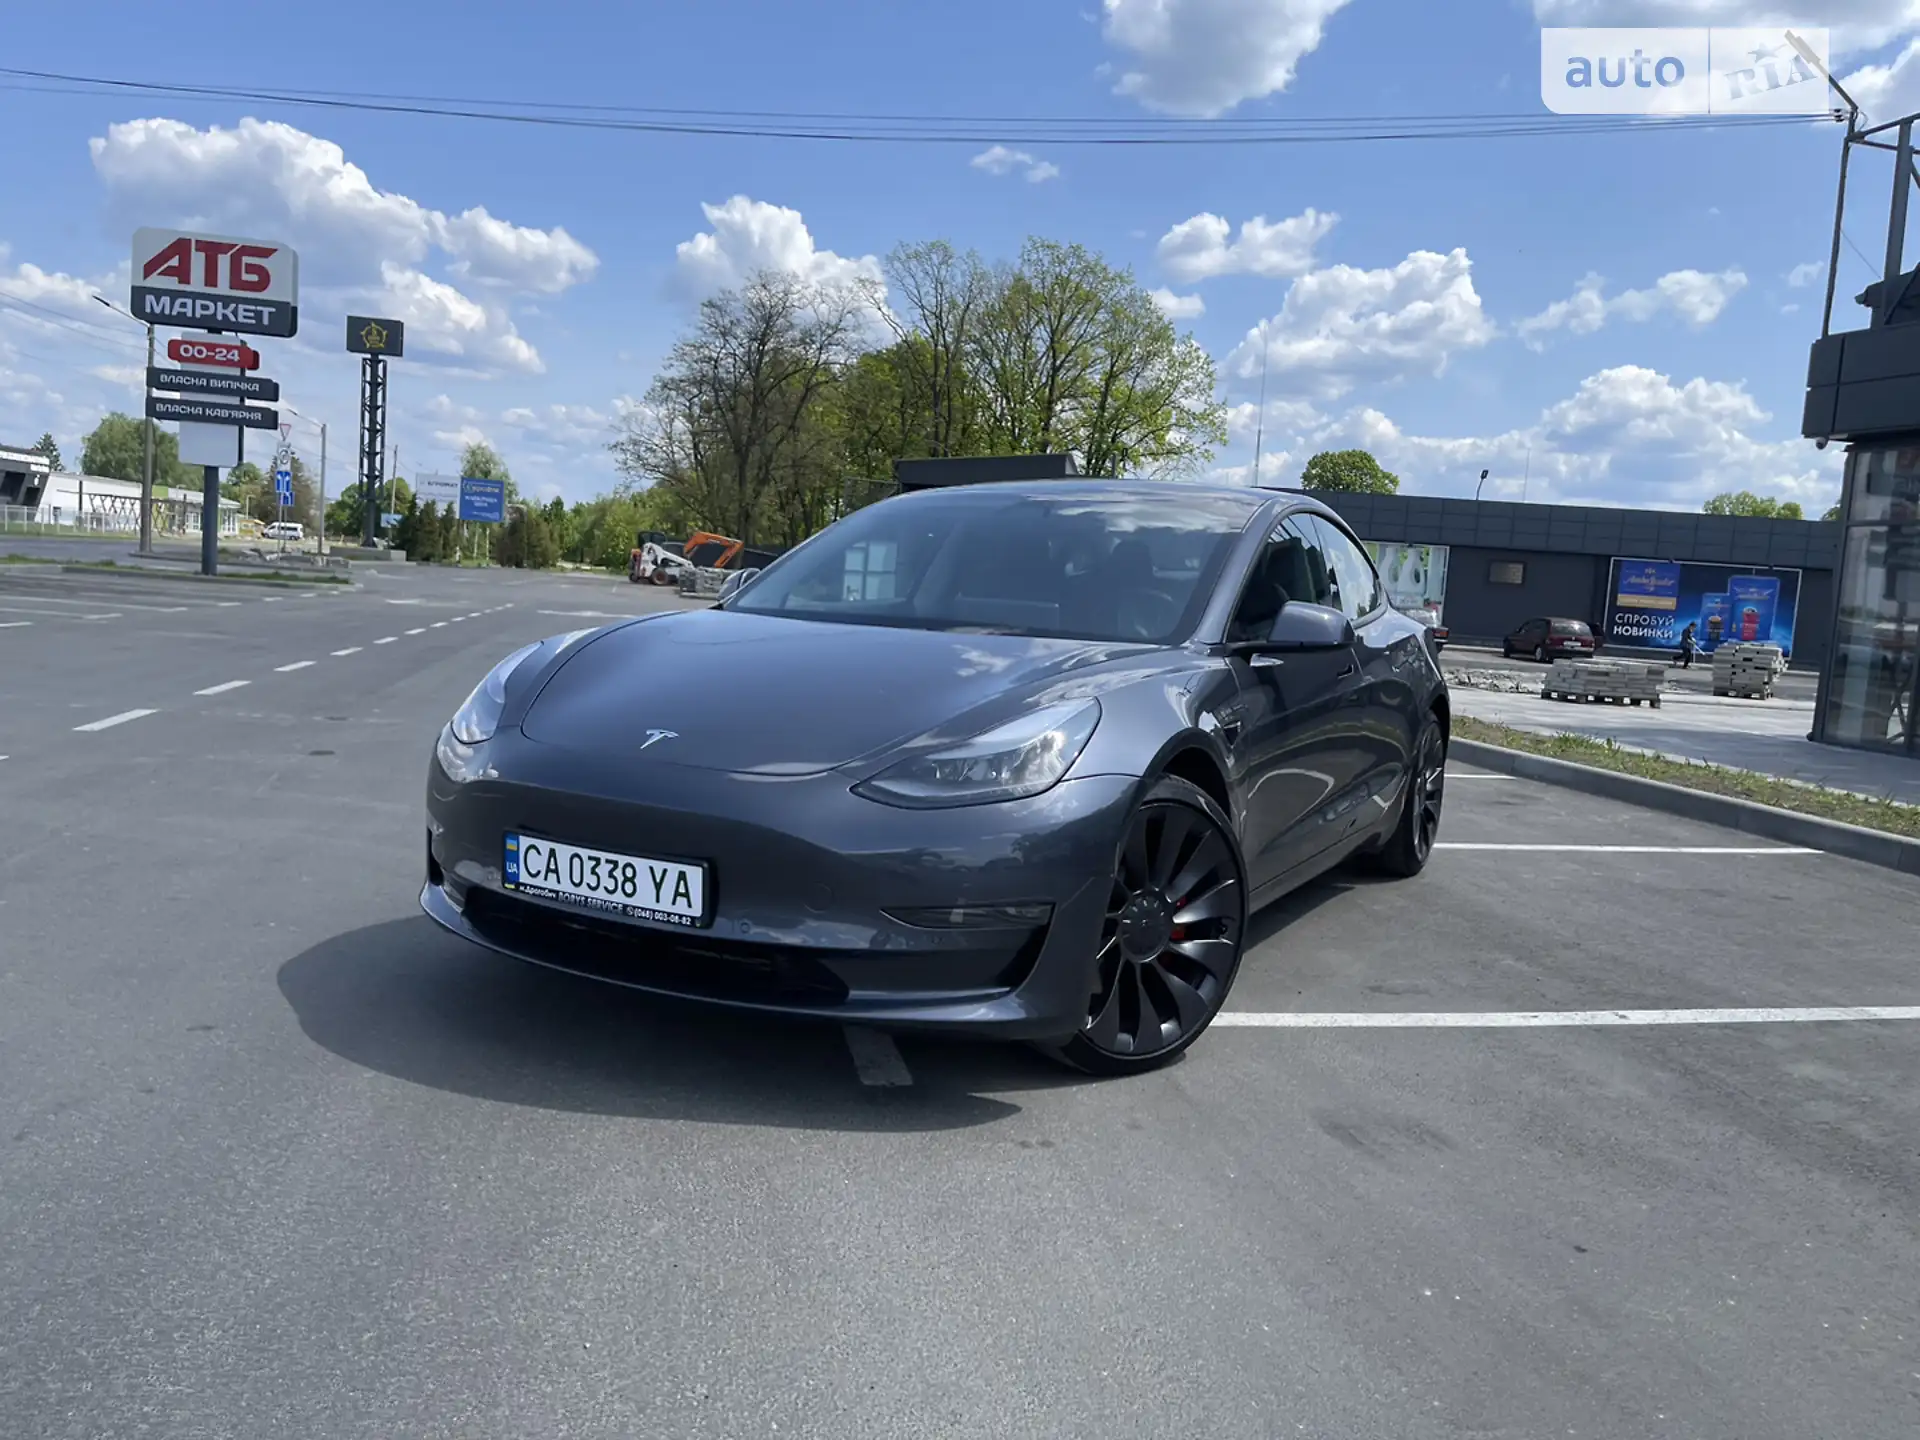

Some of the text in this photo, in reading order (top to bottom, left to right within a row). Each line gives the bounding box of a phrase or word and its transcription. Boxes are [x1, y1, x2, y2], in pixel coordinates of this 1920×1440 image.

[143, 237, 278, 293] АТБ
[144, 294, 276, 326] МАРКЕТ
[180, 344, 240, 362] 00-24
[160, 373, 260, 393] ВЛАСНА ВИПІЧКА
[155, 403, 262, 421] ВЛАСНА КАВ'ЯРНЯ
[1615, 612, 1675, 626] СПРОБУЙ
[1613, 625, 1673, 639] НОВИНКИ
[506, 861, 518, 874] UA
[523, 844, 692, 909] CA 0338 YA
